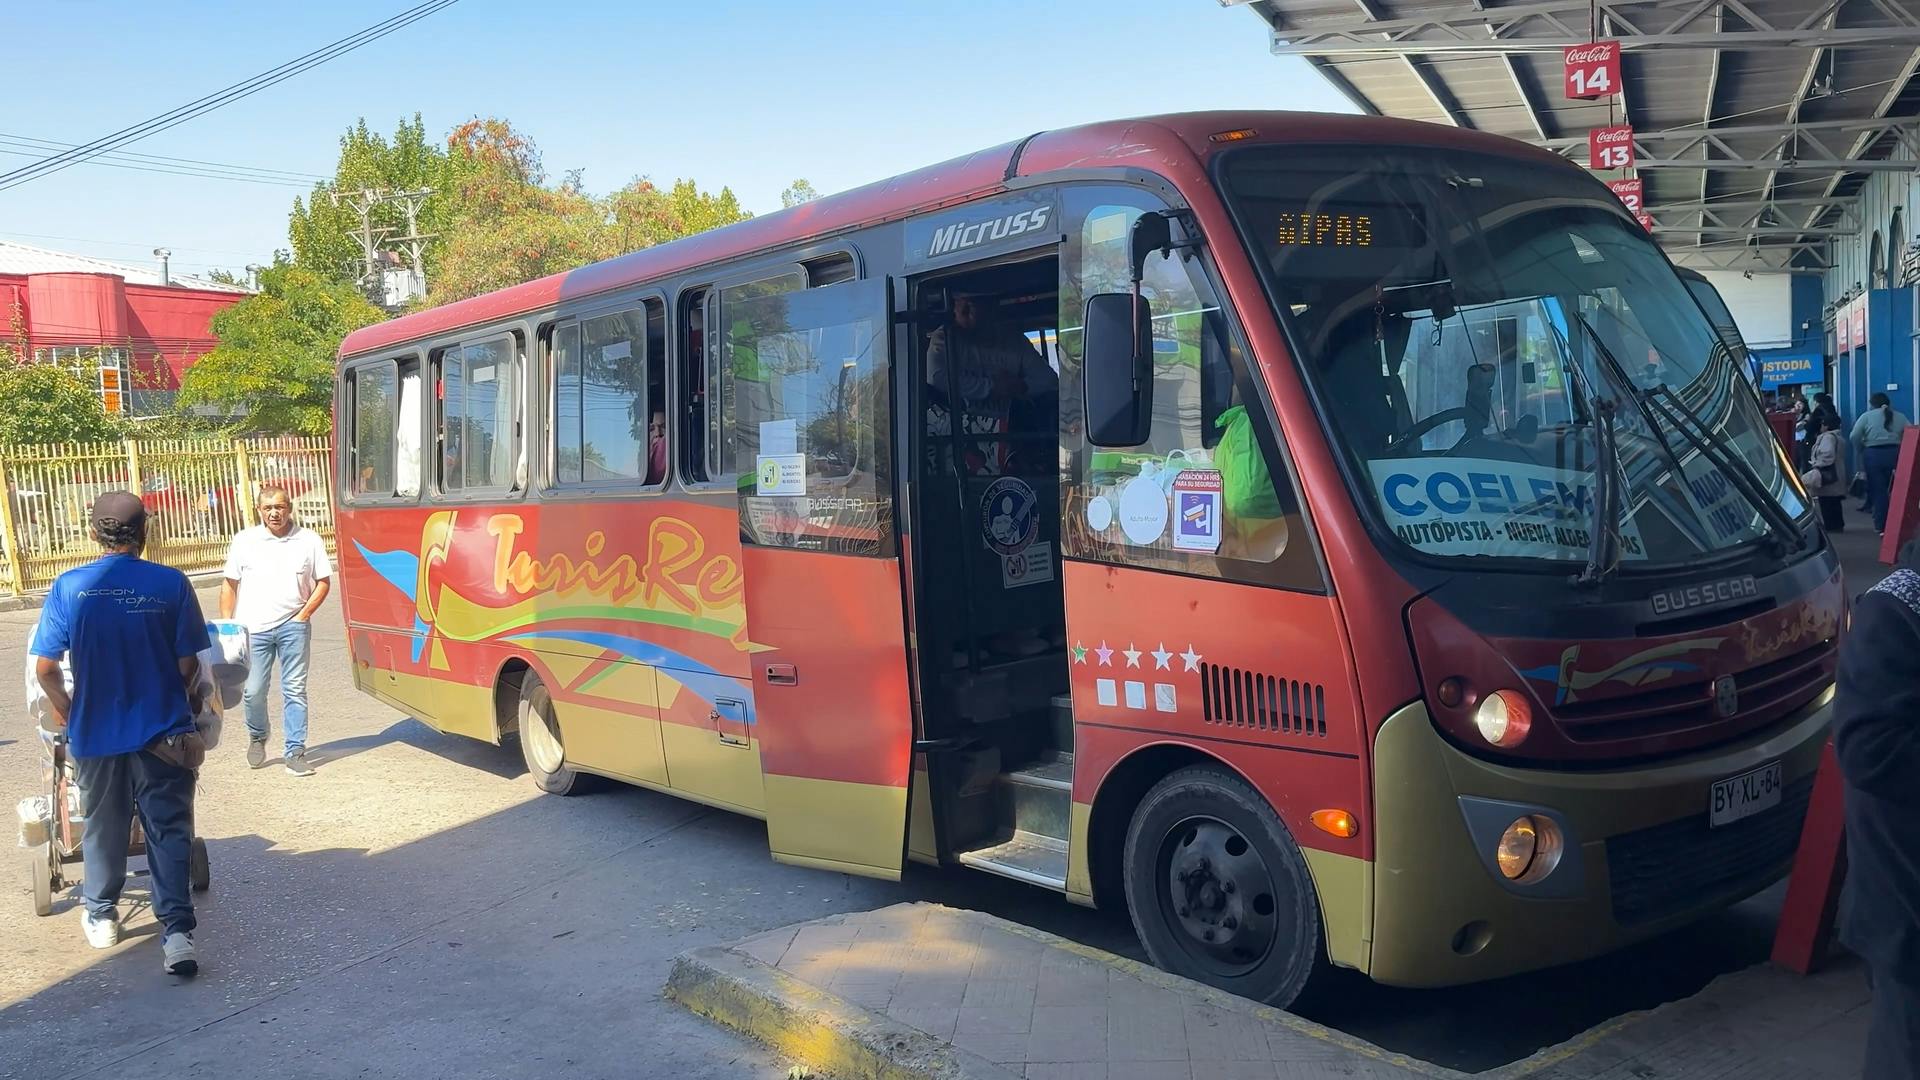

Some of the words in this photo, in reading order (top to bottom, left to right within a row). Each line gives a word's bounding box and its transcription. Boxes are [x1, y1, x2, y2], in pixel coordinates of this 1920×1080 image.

[1566, 45, 1613, 64] Coca-Cola
[1570, 67, 1610, 94] 14
[1597, 129, 1631, 143] Coca-Cola
[1600, 146, 1629, 167] 13
[1619, 194, 1639, 211] 2
[929, 206, 1050, 256] Micruss
[1383, 472, 1627, 527] COELEM
[1396, 520, 1494, 545] AUTOPISTA
[1505, 521, 1554, 544] NUEVA
[487, 513, 744, 617] TurisRe
[1652, 577, 1758, 614] BUSSCAR
